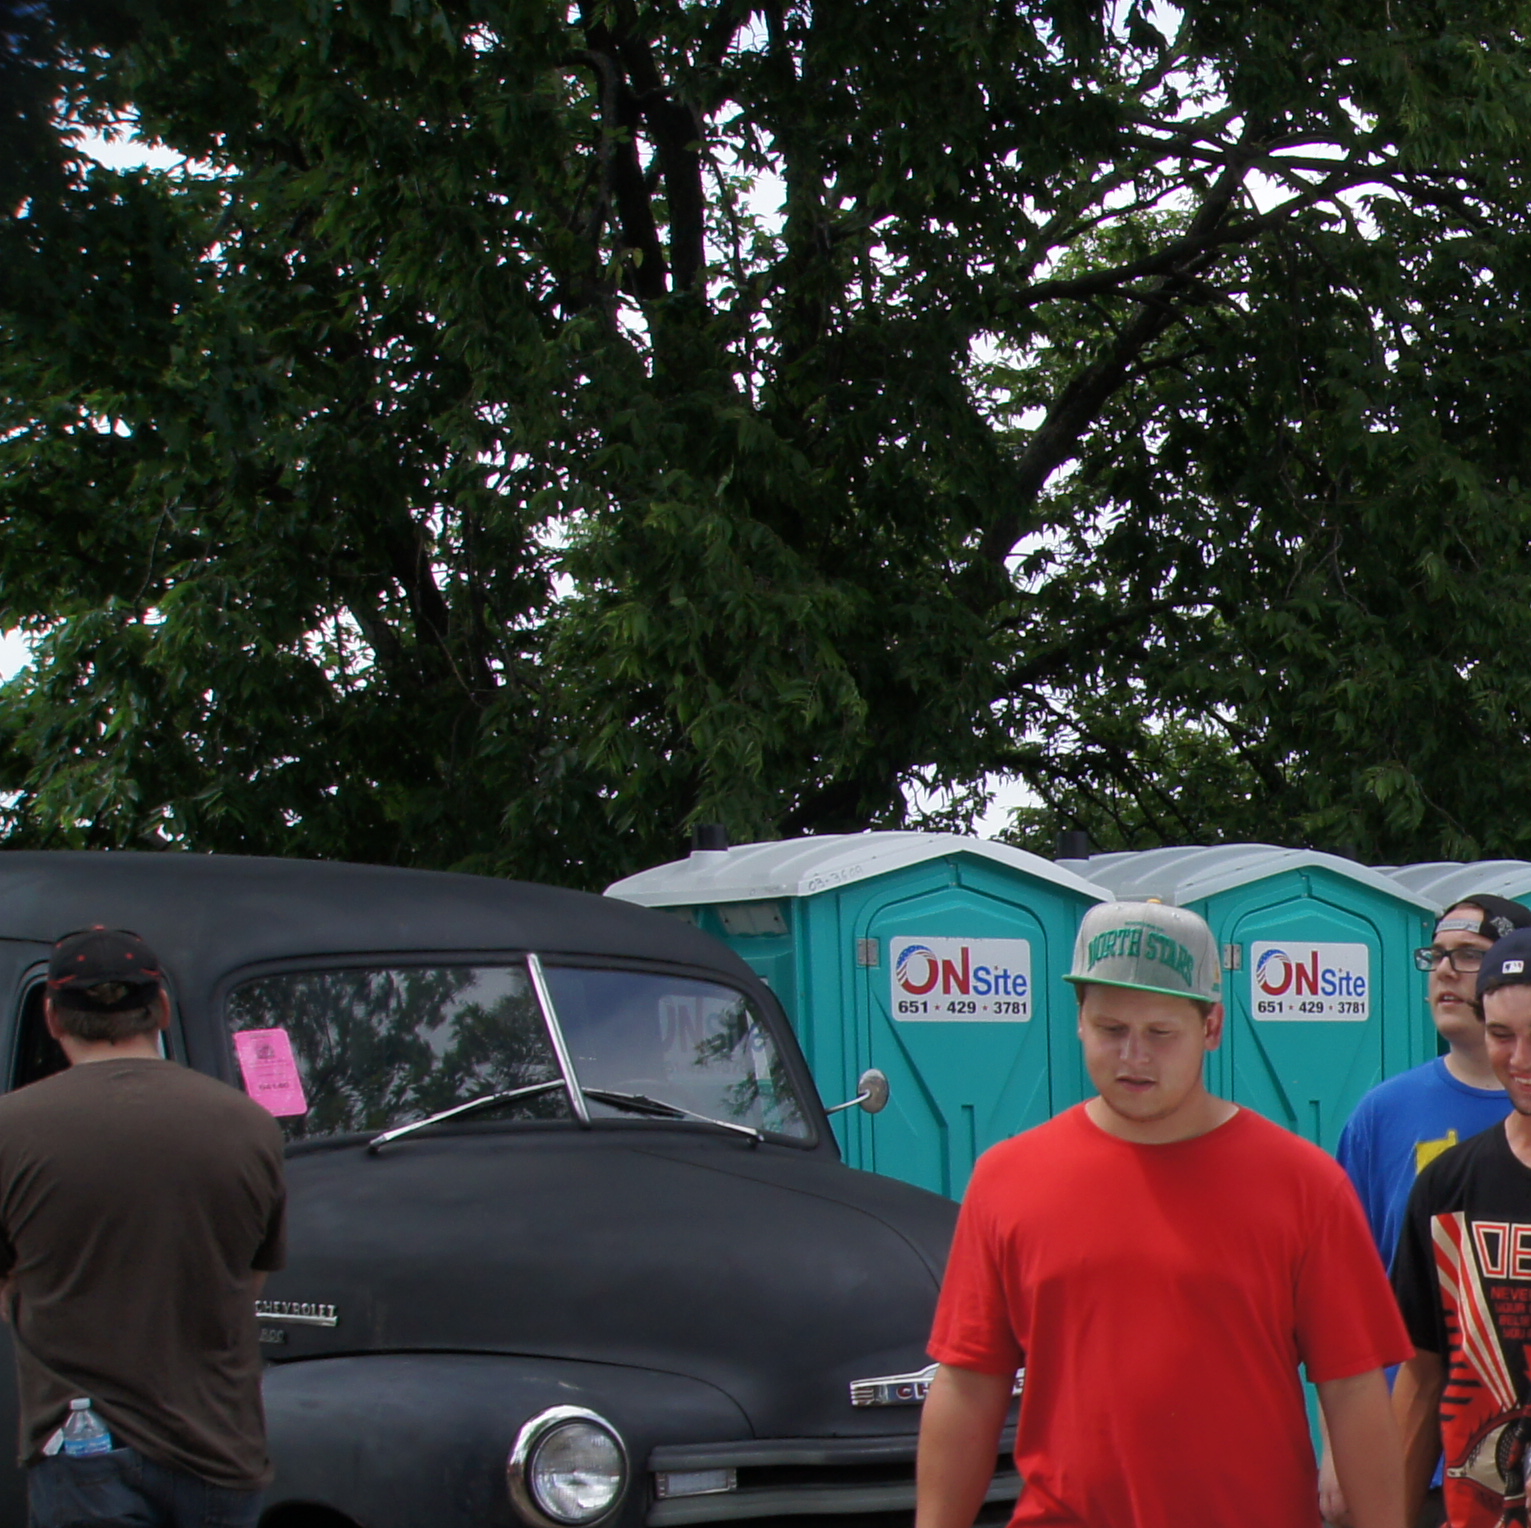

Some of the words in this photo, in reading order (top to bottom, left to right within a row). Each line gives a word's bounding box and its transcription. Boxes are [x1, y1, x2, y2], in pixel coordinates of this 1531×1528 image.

[896, 945, 1027, 996] ONSite
[1088, 928, 1144, 972] NORTH
[1146, 931, 1195, 988] STARS
[1257, 949, 1366, 997] ONSite
[898, 1001, 928, 1013] 651
[947, 1001, 976, 1013] 429
[994, 1002, 1027, 1014] 3781
[1258, 1001, 1283, 1013] 651
[1299, 1002, 1324, 1013] 429
[1338, 1002, 1365, 1014] 3781
[254, 1300, 336, 1318] CHEVROLET
